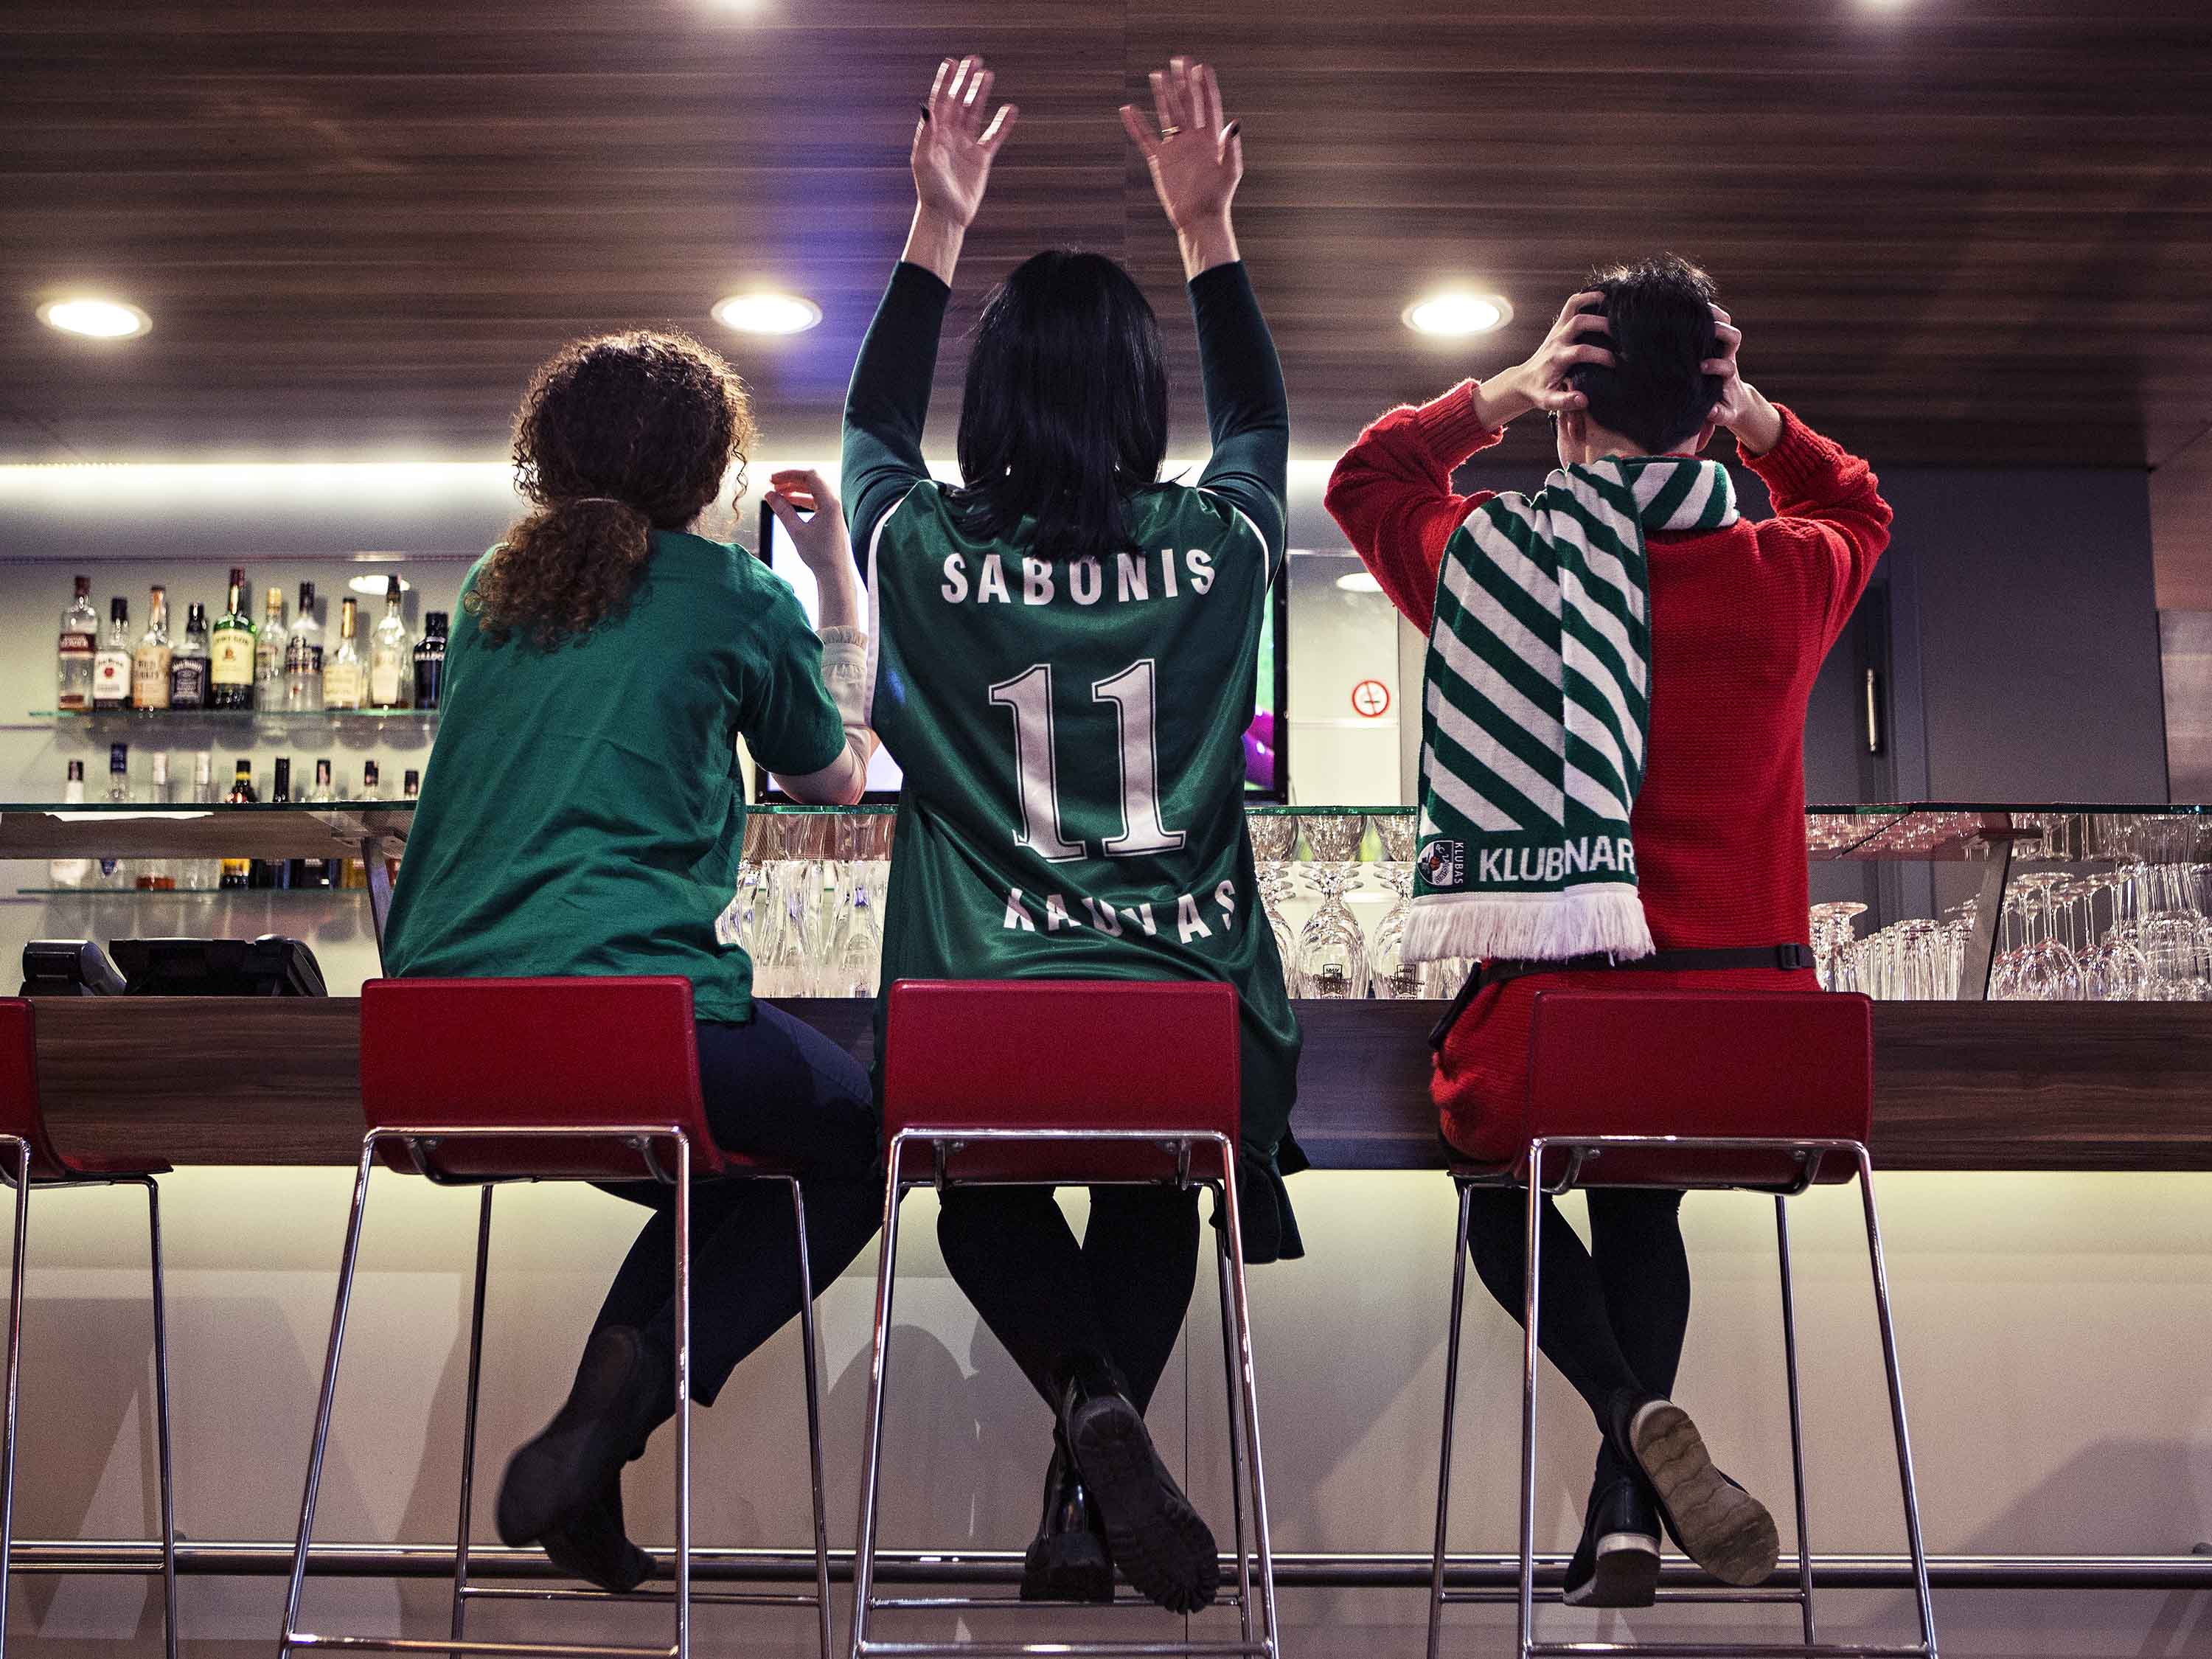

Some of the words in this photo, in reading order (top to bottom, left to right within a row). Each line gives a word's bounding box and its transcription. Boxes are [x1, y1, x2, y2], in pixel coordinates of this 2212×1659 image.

[941, 548, 1216, 606] SABONIS
[989, 658, 1186, 863] 11
[1454, 842, 1464, 884] KLUBAS
